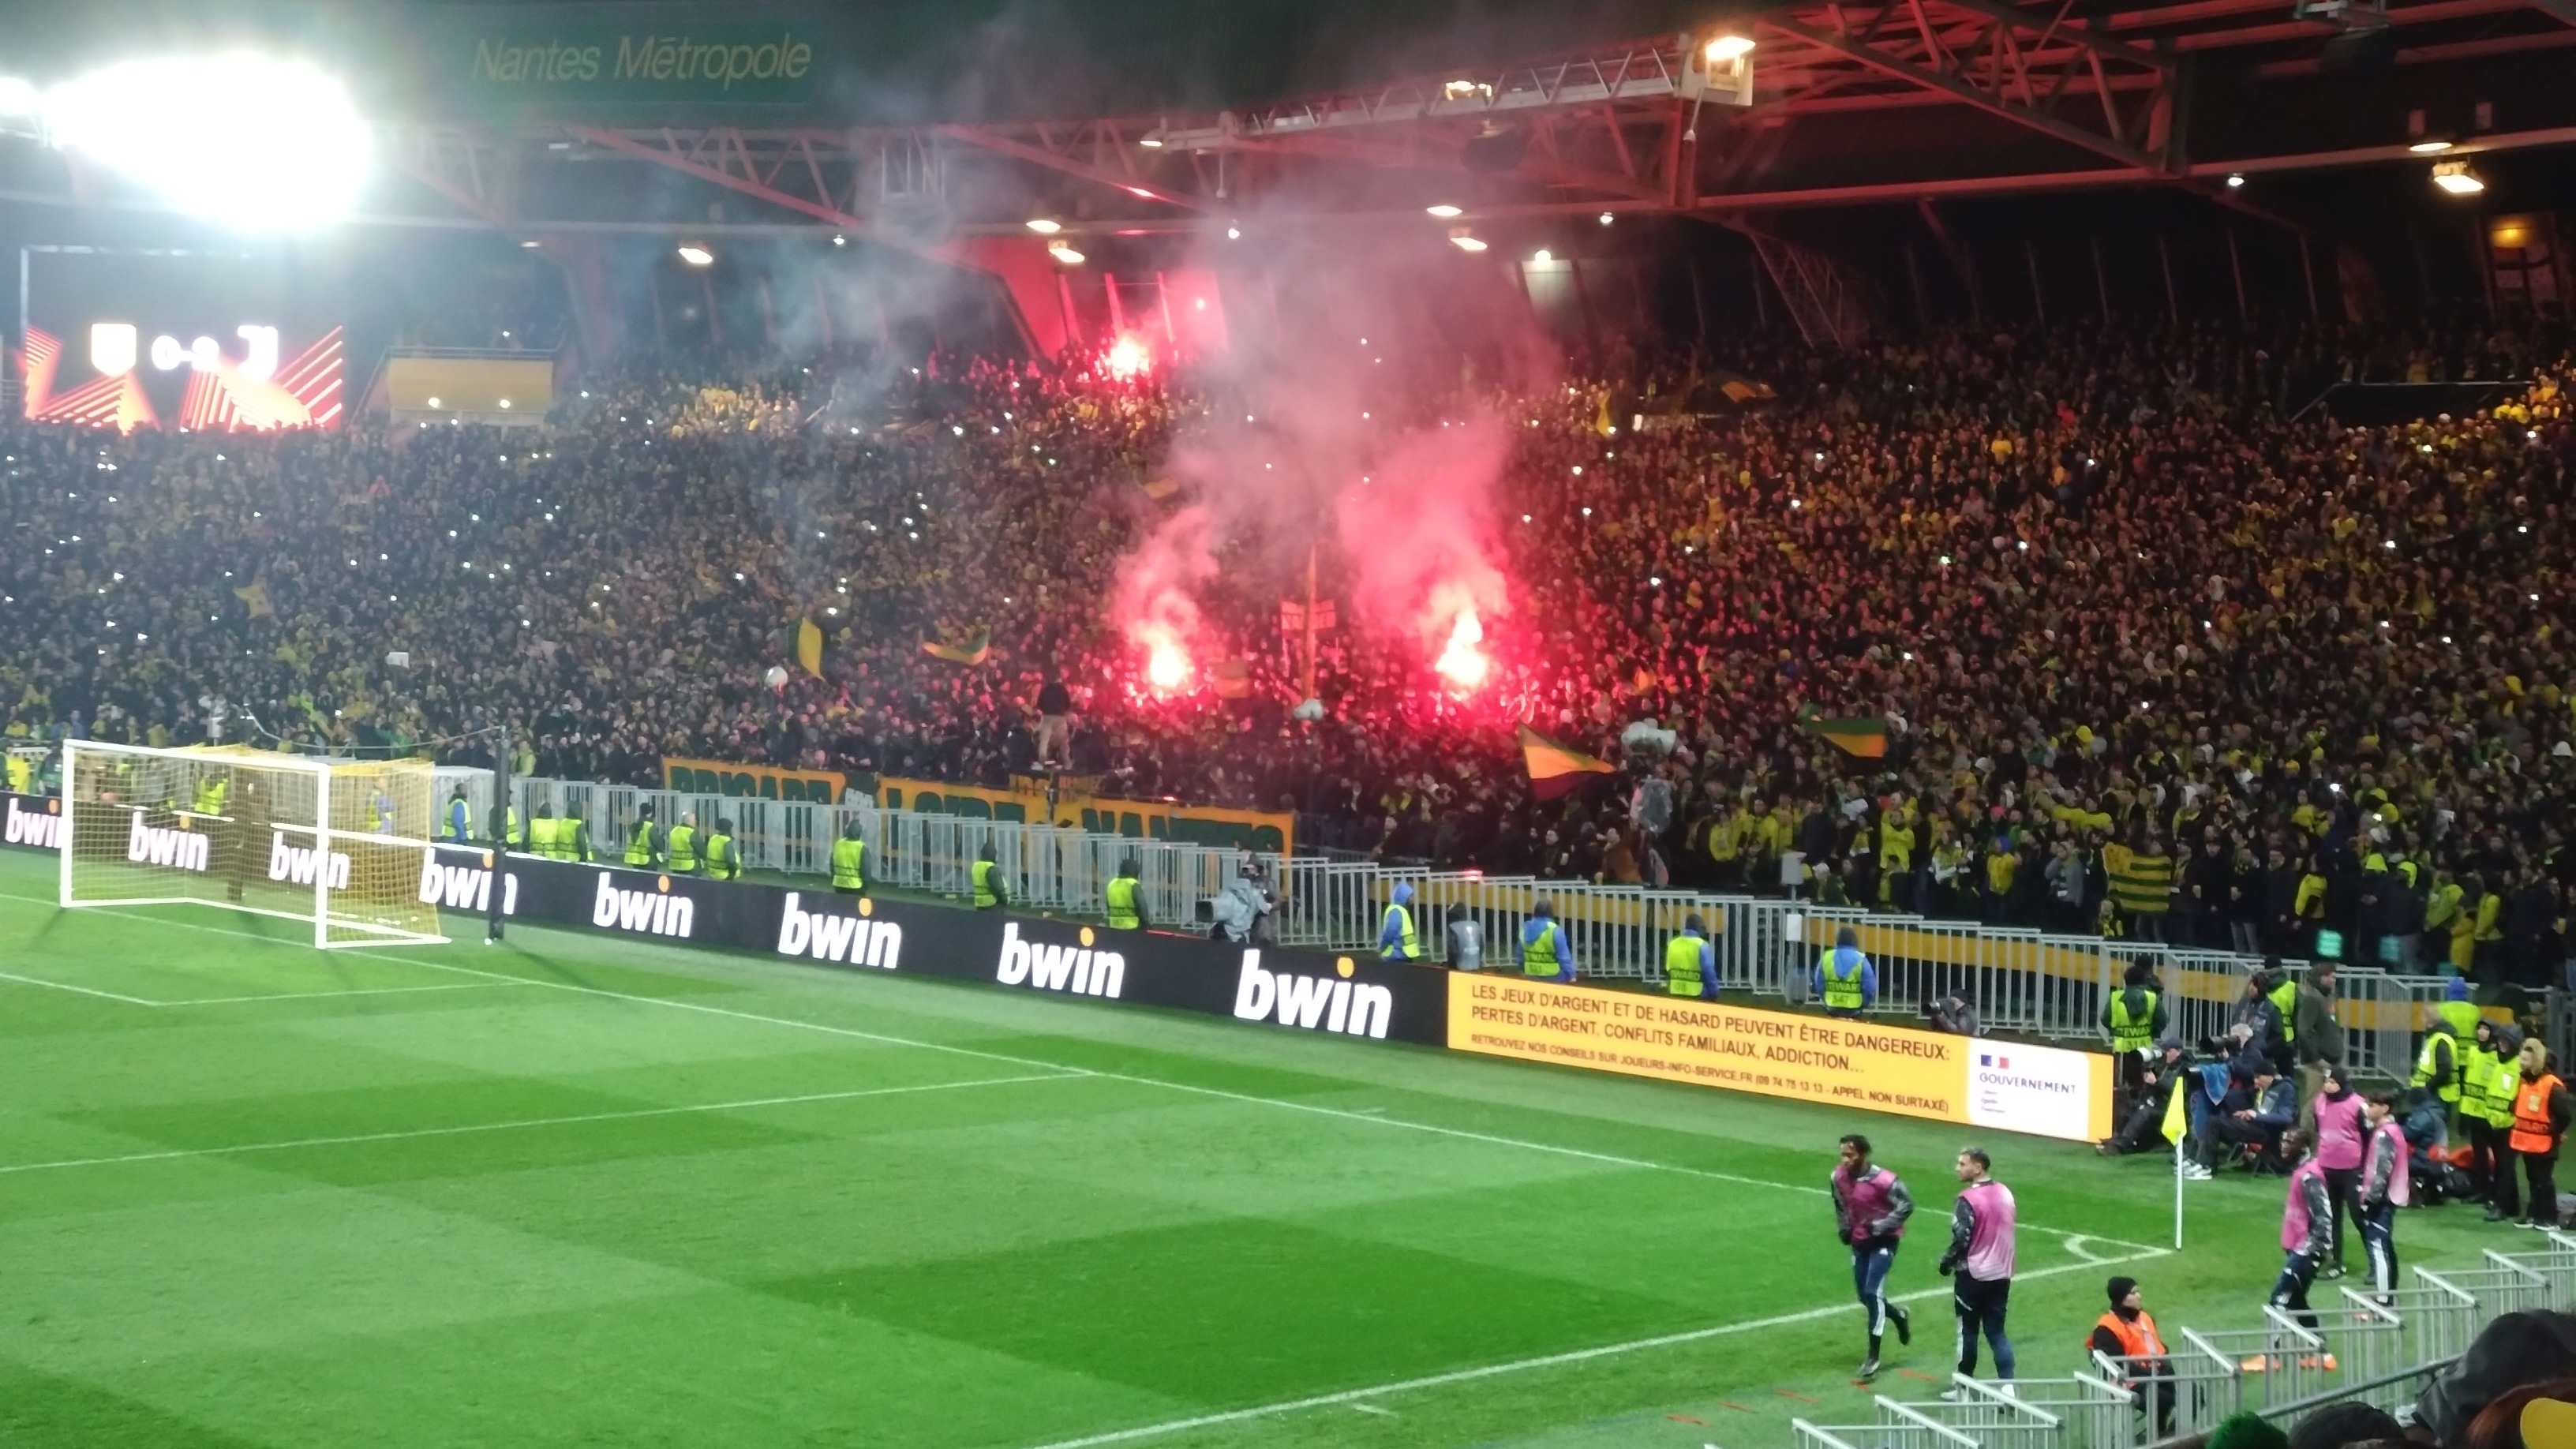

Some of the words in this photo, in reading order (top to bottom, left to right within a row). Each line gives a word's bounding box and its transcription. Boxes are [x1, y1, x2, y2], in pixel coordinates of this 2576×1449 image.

[472, 37, 601, 81] Nantes
[128, 811, 208, 871] bwin
[593, 871, 694, 938] bwin
[777, 892, 902, 969] bwin
[996, 921, 1125, 998] bwin
[1234, 949, 1393, 1039] bwin
[1472, 983, 1496, 1001] LES
[1500, 987, 1535, 1006] JEUX
[1540, 992, 1608, 1017] D'ARGENT
[1614, 1002, 1631, 1017] ET
[1635, 1005, 1654, 1021] DE
[1660, 1007, 1720, 1030] HASARD
[1725, 1016, 1795, 1041] PEUVENT
[1799, 1024, 1839, 1046] ÊTRE
[1845, 1032, 1950, 1061] DANGEREUX:
[1472, 1005, 1523, 1026] PERTES
[1604, 1023, 1674, 1046] CONFLITS
[1679, 1032, 1760, 1060] FAMILIAUX,
[1471, 1034, 1525, 1051] RETROUVEZ
[1529, 1041, 1547, 1054] NOS
[1550, 1044, 1595, 1061] CONSEILS
[1598, 1051, 1617, 1064] SUR
[1800, 1081, 1809, 1091] 13
[1814, 1083, 1823, 1094] 13
[1833, 1085, 1865, 1100] APPEL
[1869, 1091, 1893, 1104] NON
[1896, 1092, 1949, 1114] SURTAXÉ)
[1979, 1073, 2076, 1095] GOUVERNEMENT
